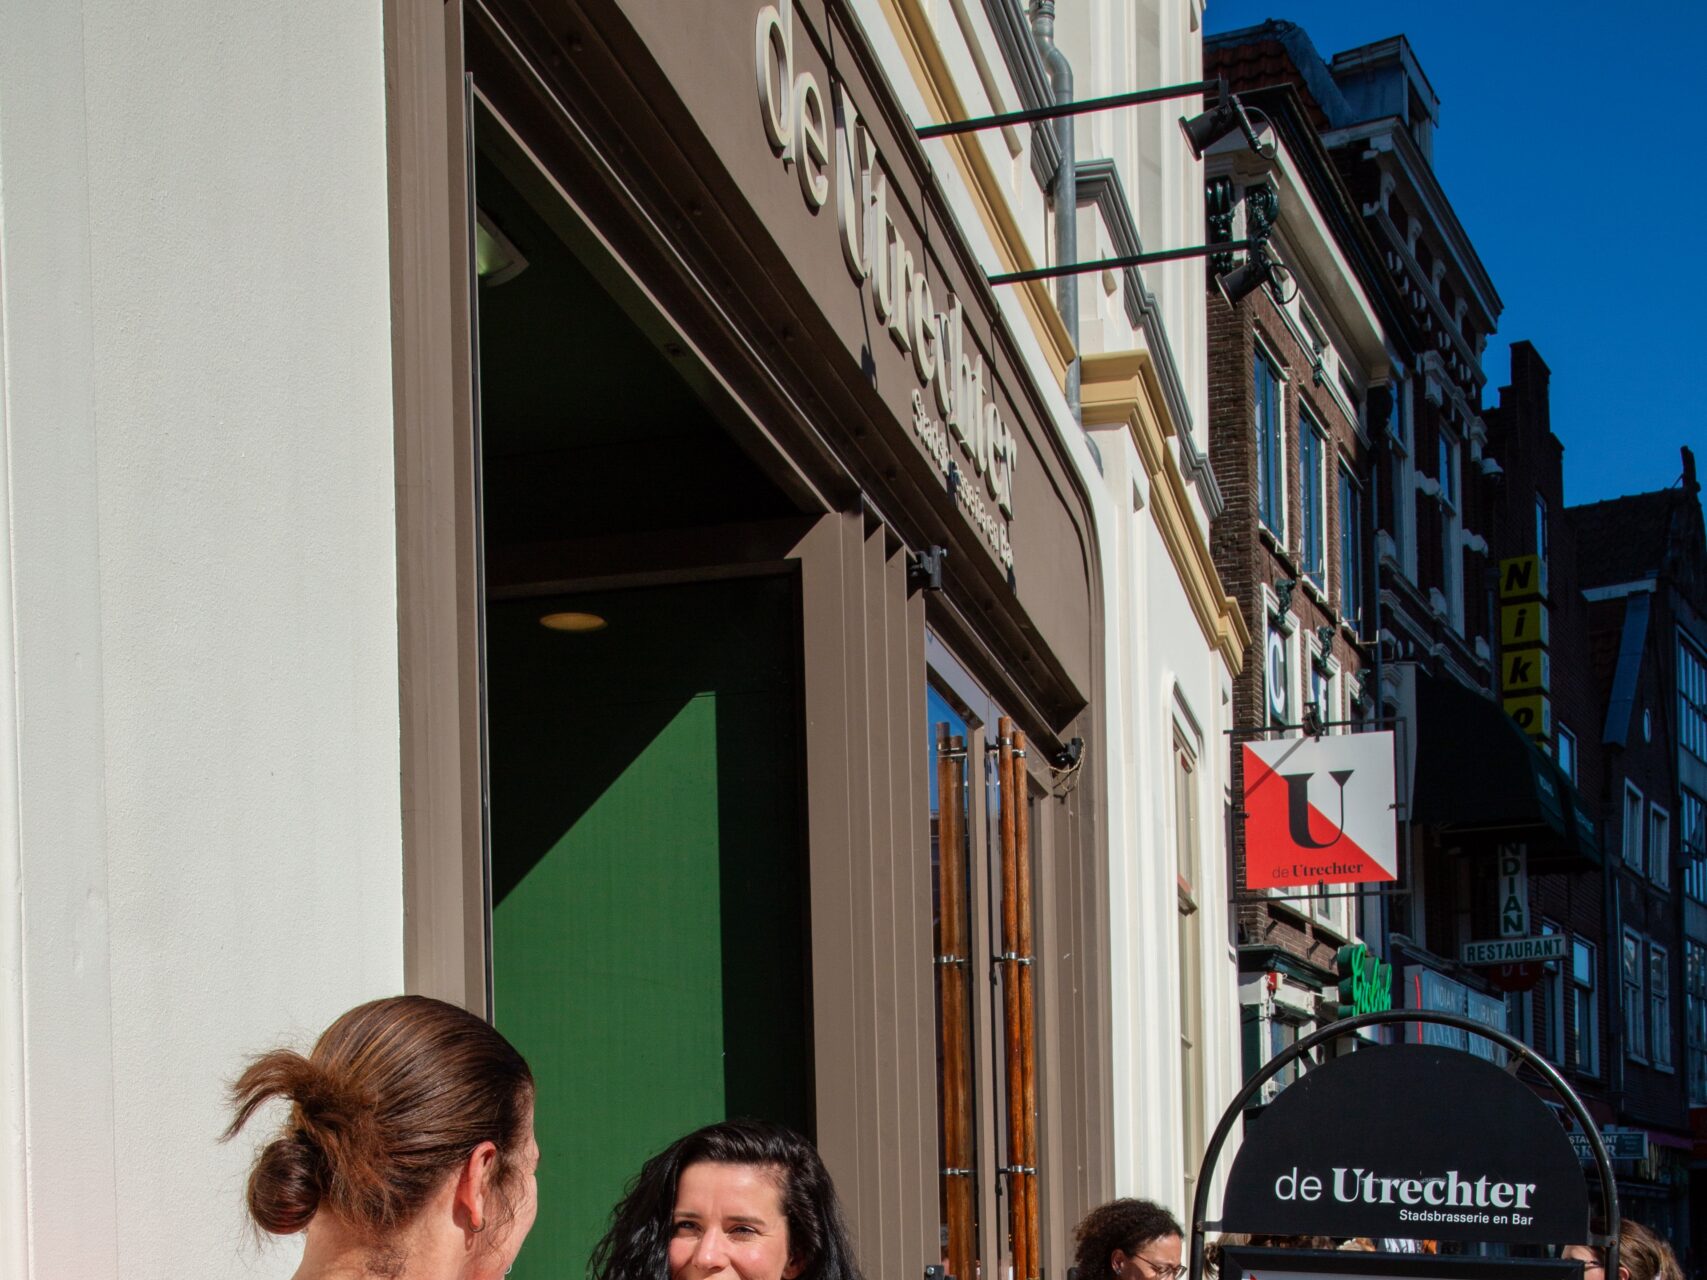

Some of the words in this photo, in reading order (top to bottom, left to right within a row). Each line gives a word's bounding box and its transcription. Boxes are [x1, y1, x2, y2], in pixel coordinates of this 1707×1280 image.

[755, 0, 828, 207] de
[834, 78, 1017, 522] Utrechter
[1281, 770, 1354, 848] U
[1272, 866, 1289, 878] de
[1292, 862, 1364, 877] Utrechter
[1467, 939, 1562, 962] RESTAURANT
[1275, 1166, 1322, 1200] de
[1332, 1168, 1536, 1209] Utrechter
[1400, 1209, 1490, 1224] Stadsbrasserie
[1493, 1214, 1508, 1224] en
[1512, 1212, 1534, 1226] Bar
